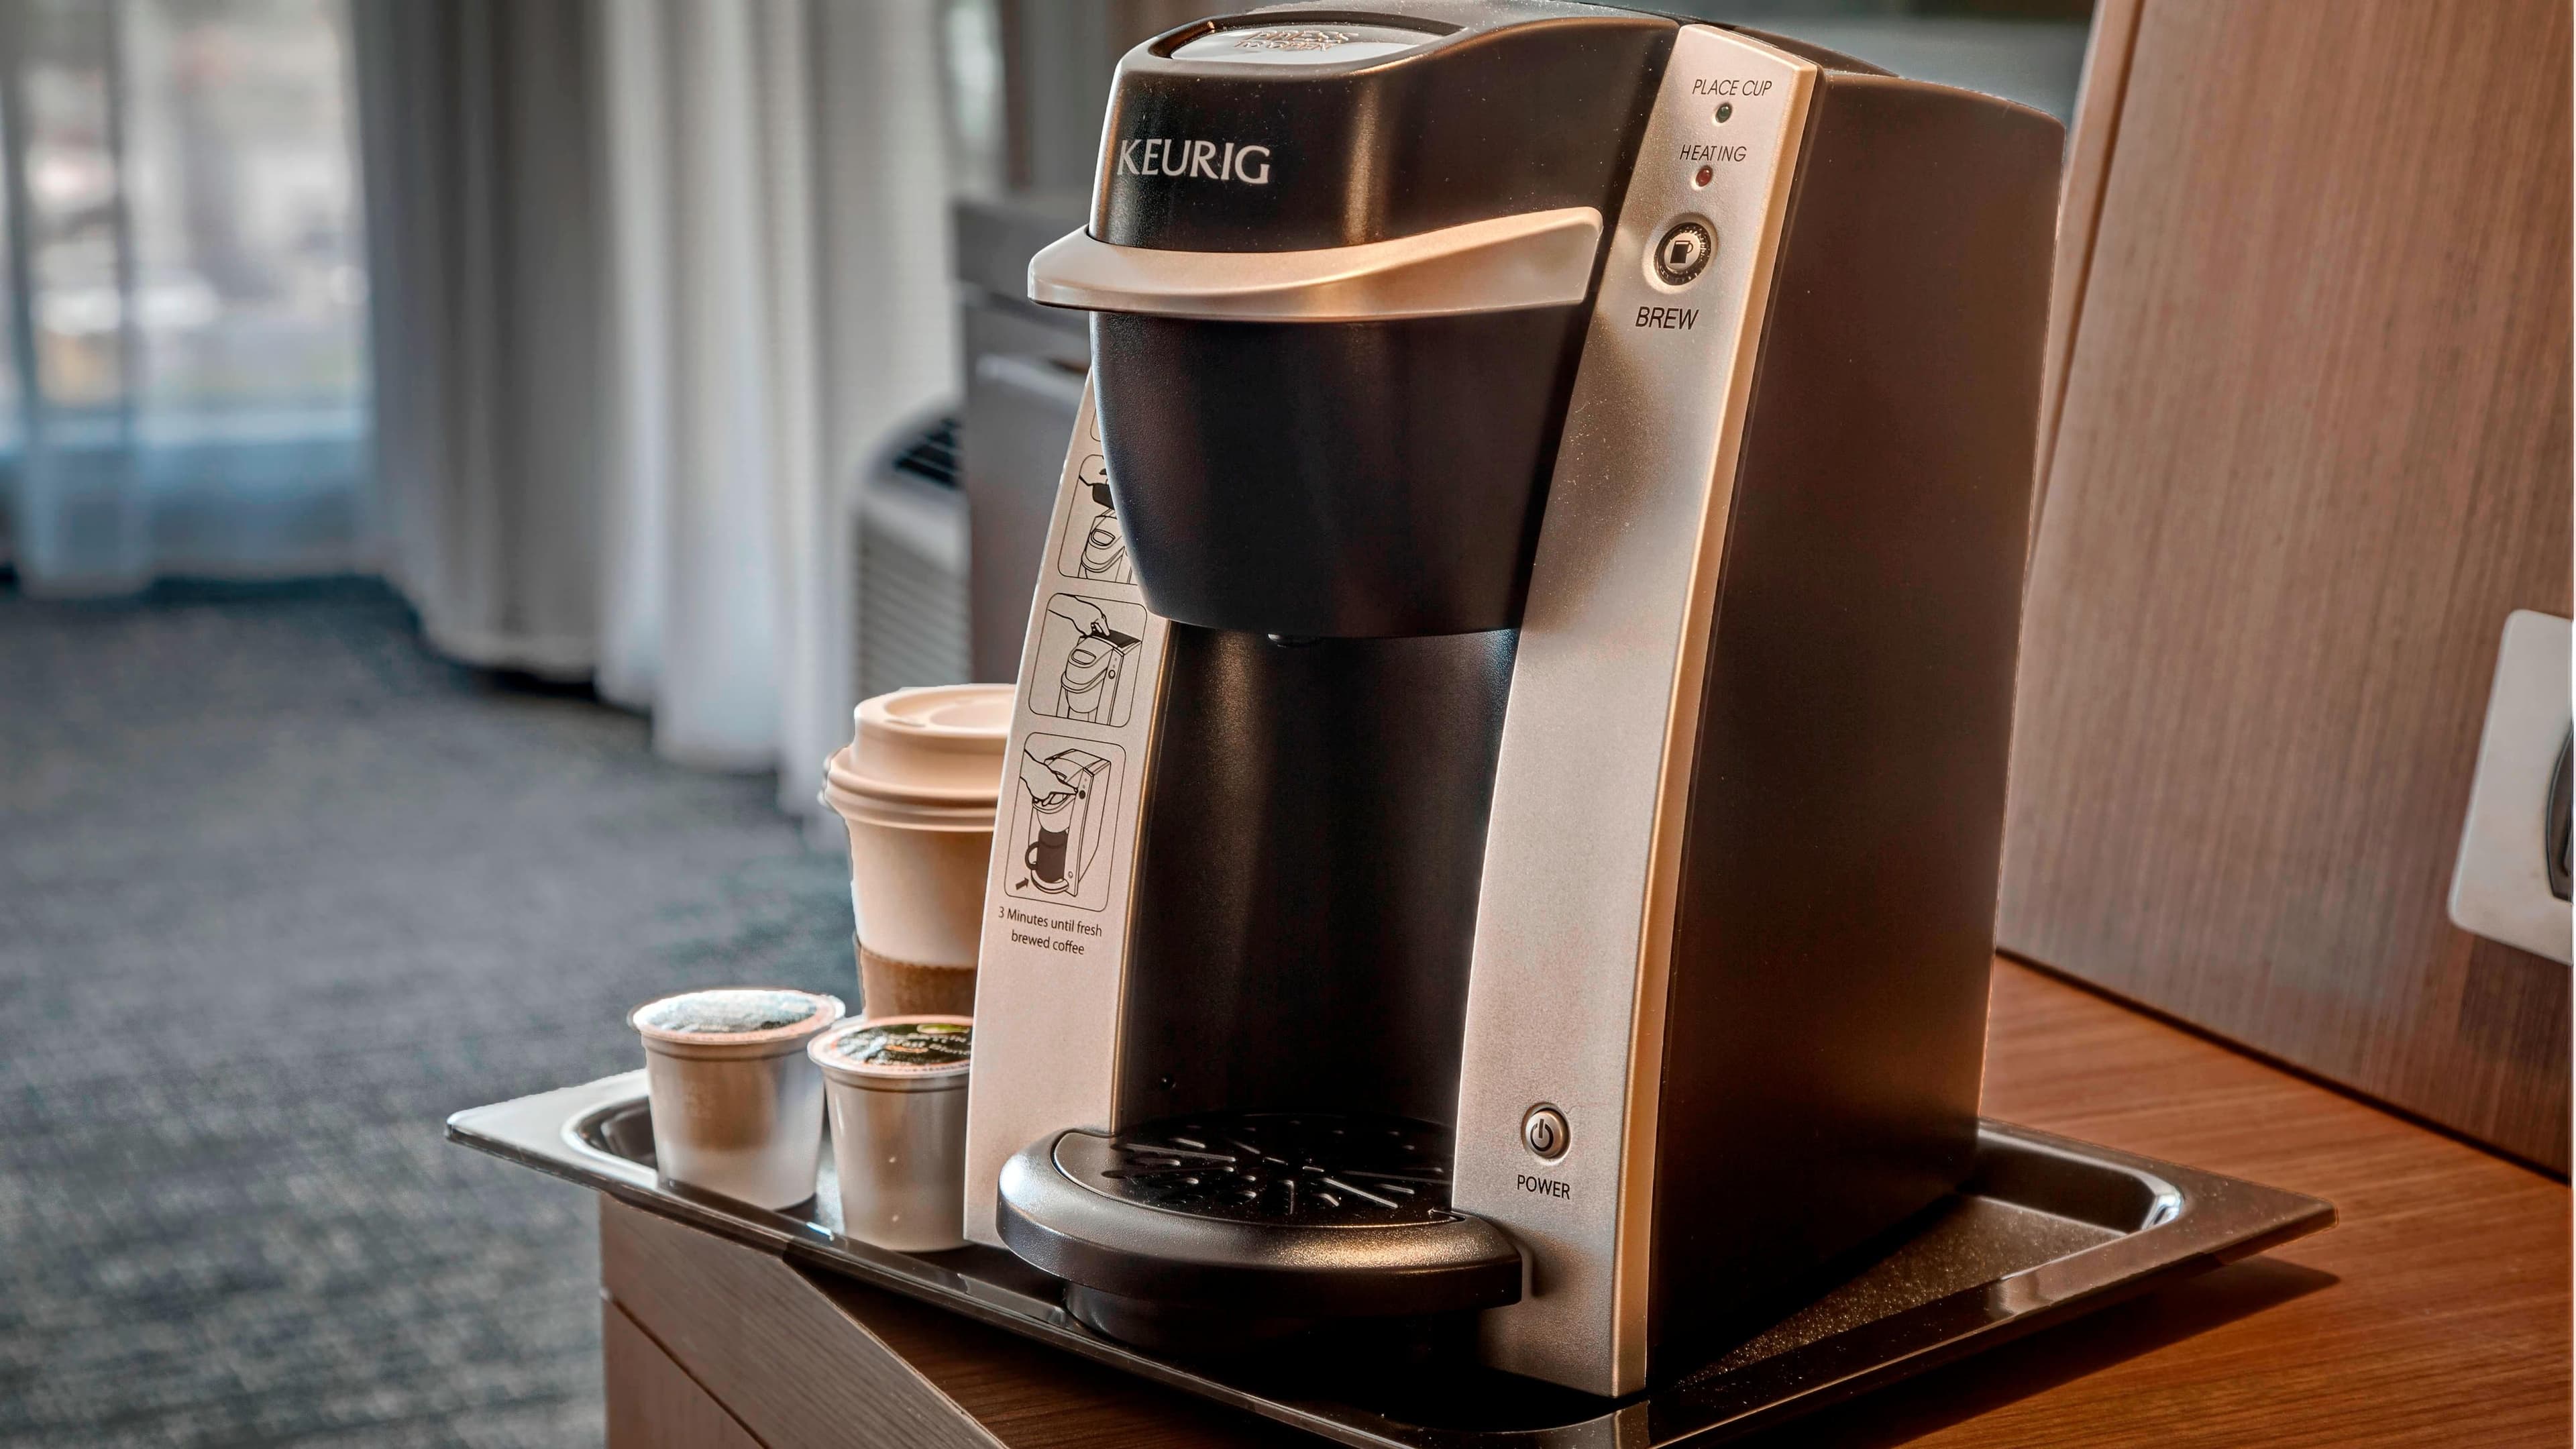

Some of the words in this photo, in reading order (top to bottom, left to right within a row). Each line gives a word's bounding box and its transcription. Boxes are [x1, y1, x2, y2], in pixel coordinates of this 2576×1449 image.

[1692, 78, 1739, 97] PLACE
[1741, 80, 1773, 97] CUP
[1117, 138, 1271, 184] KEURIG
[1679, 144, 1748, 162] HEATING
[1635, 306, 1699, 330] BREW
[998, 906, 1005, 918] 3
[1007, 908, 1049, 928] Minutes
[1051, 919, 1075, 933] until
[1077, 920, 1102, 938] fresh
[1011, 929, 1051, 949] brewed
[1053, 940, 1085, 956] coffee
[1517, 1175, 1570, 1199] POWER
